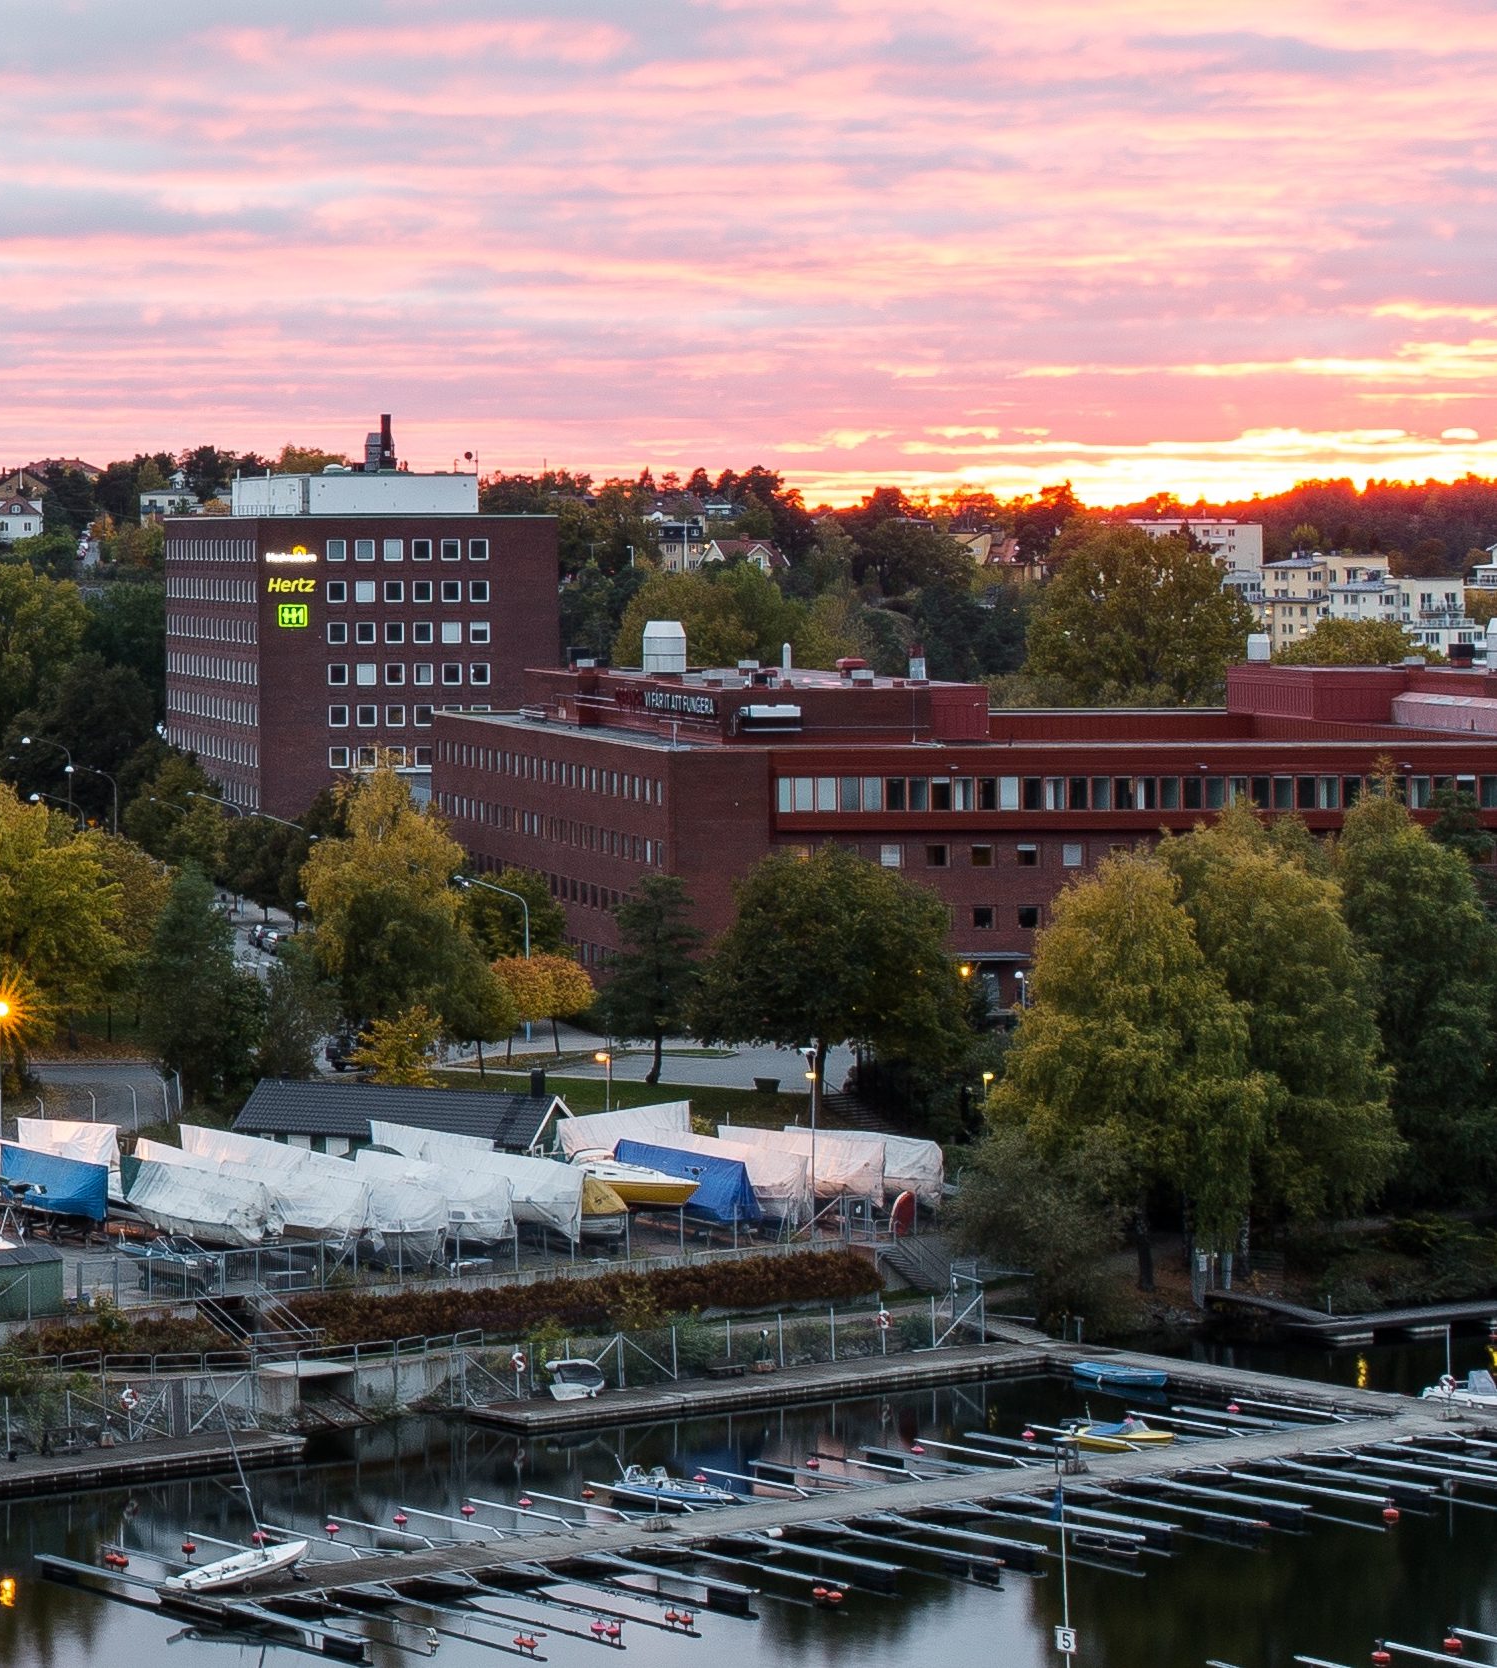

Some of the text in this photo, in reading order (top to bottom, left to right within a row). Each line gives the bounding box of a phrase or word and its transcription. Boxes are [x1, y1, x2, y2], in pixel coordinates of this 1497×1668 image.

[268, 577, 316, 592] Hertz
[670, 694, 682, 711] ATT
[1062, 1632, 1071, 1649] 5
